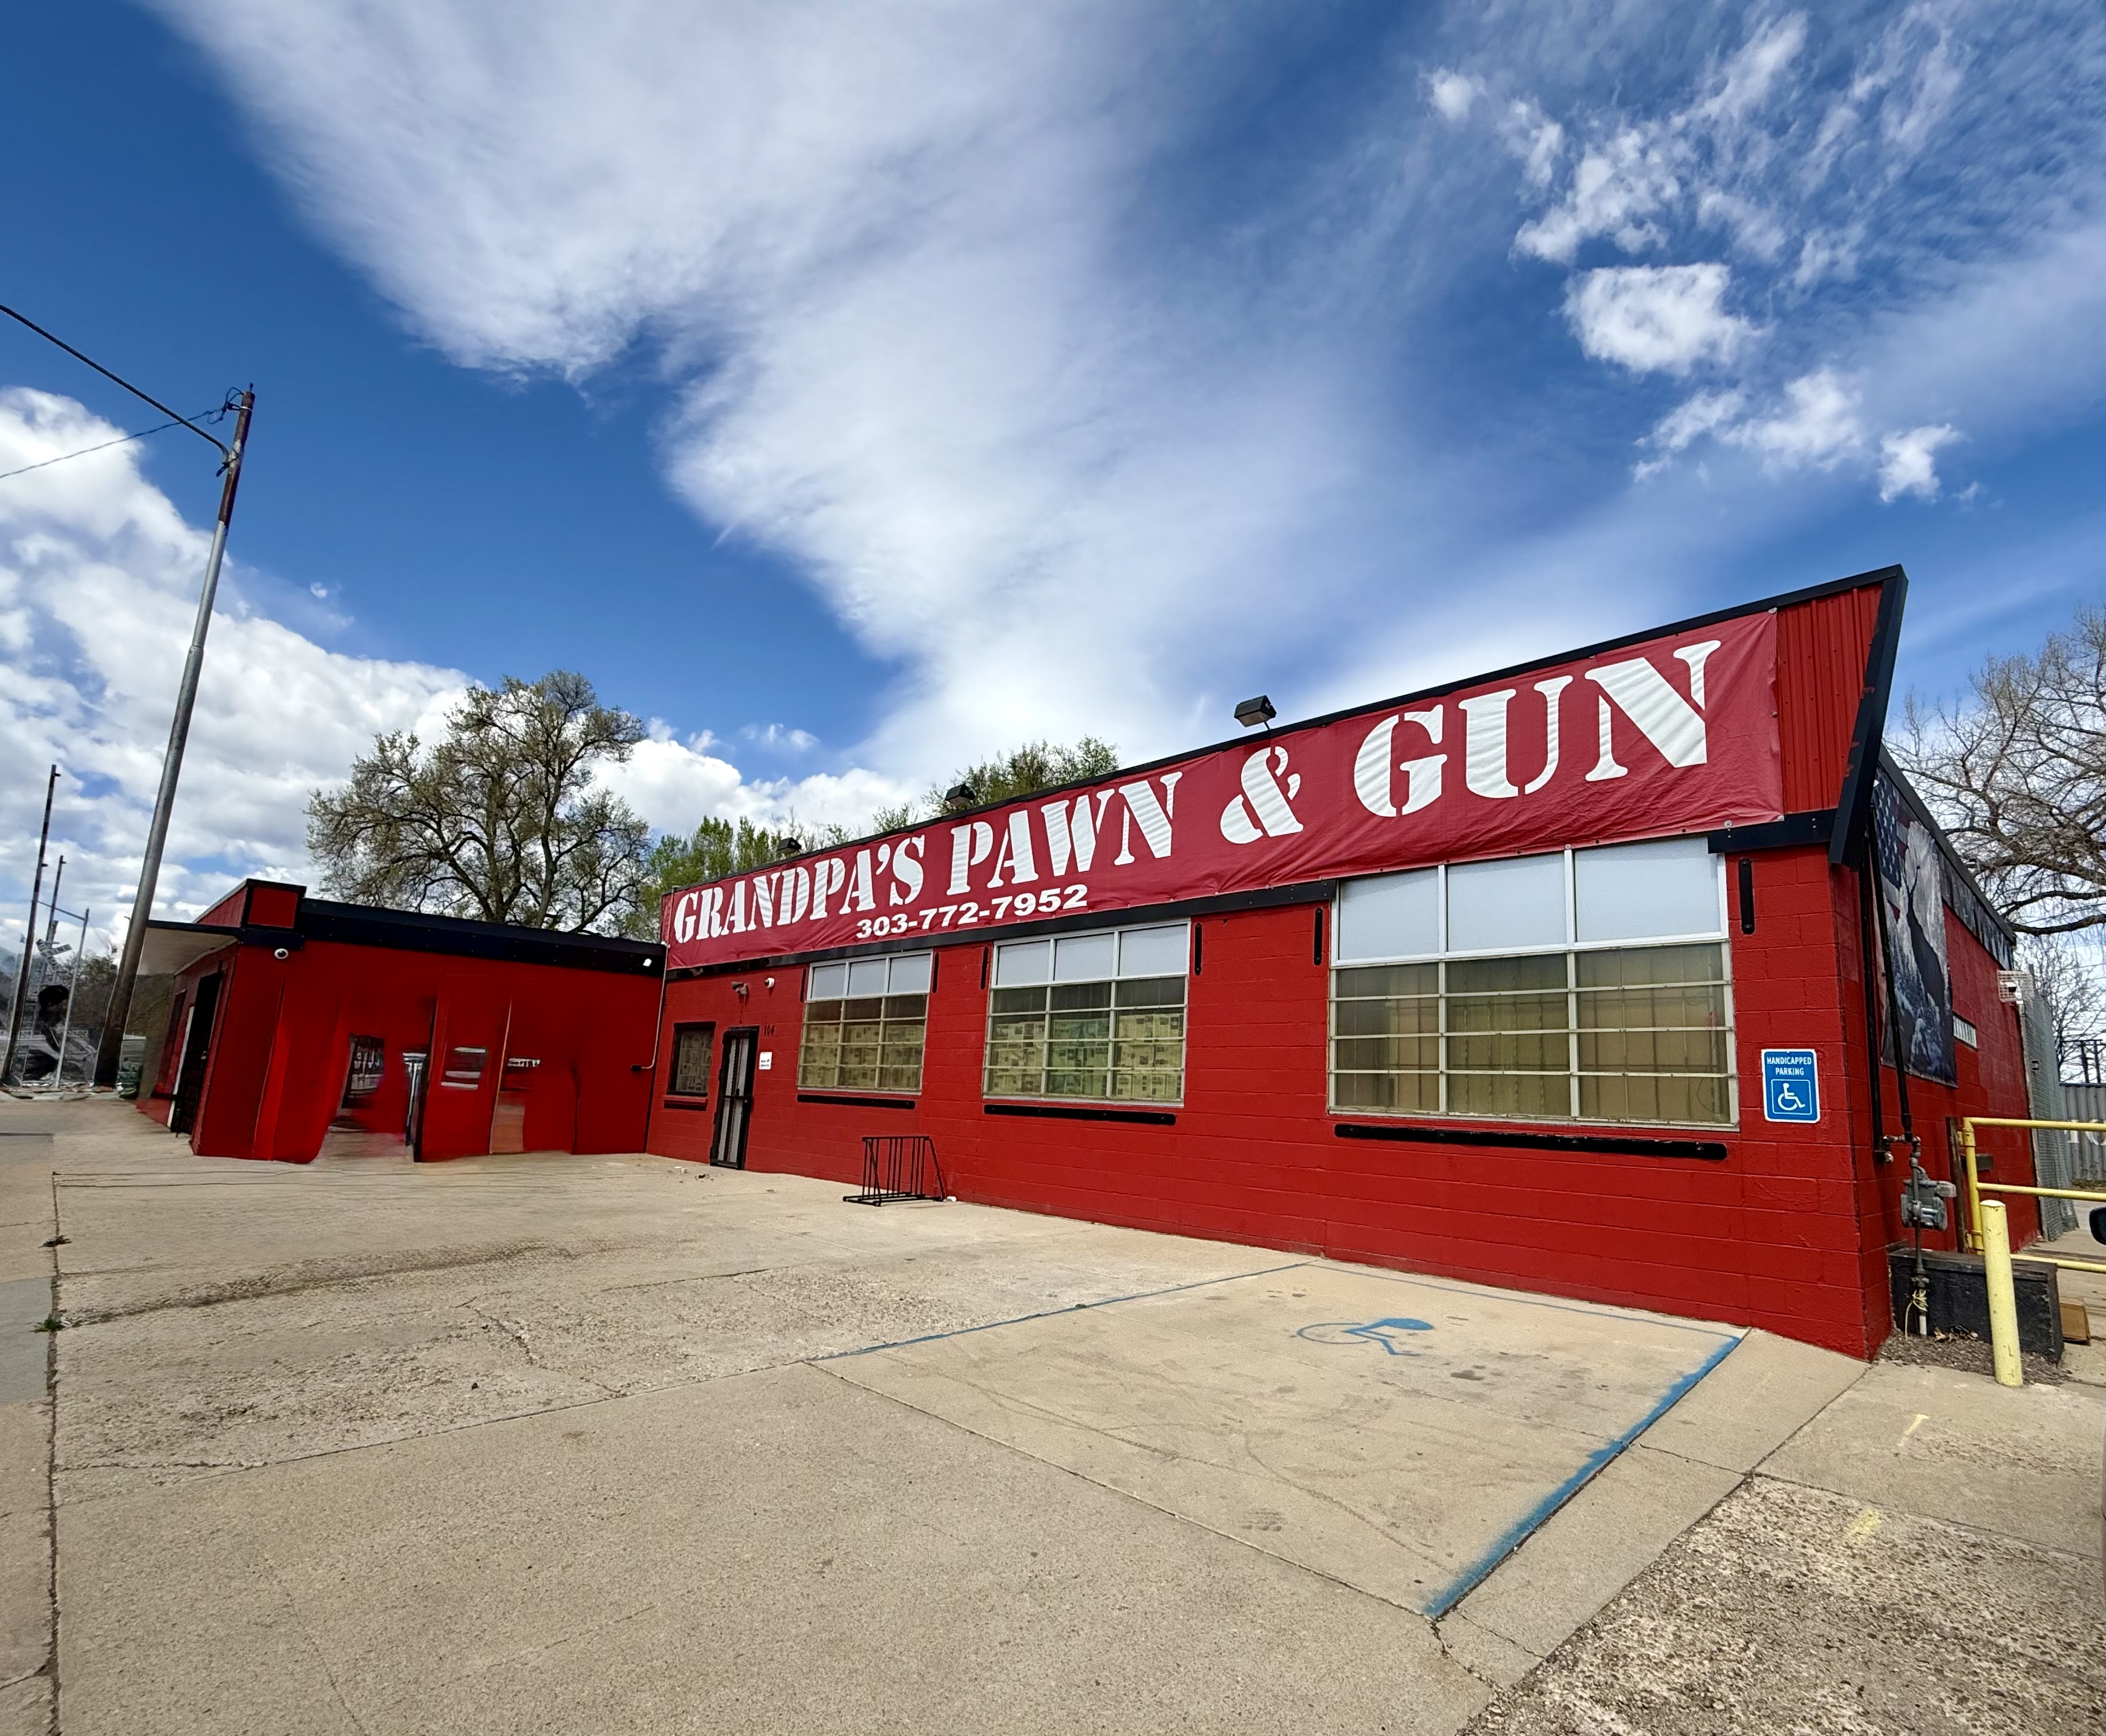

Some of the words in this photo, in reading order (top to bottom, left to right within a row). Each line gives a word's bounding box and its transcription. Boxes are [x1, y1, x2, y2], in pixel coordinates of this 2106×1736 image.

[674, 834, 925, 944] GRANDPA'S
[946, 771, 1183, 896] PAWN
[1220, 746, 1304, 844] &
[1354, 639, 1721, 817] GUN
[856, 884, 1087, 939] 303-772-7952
